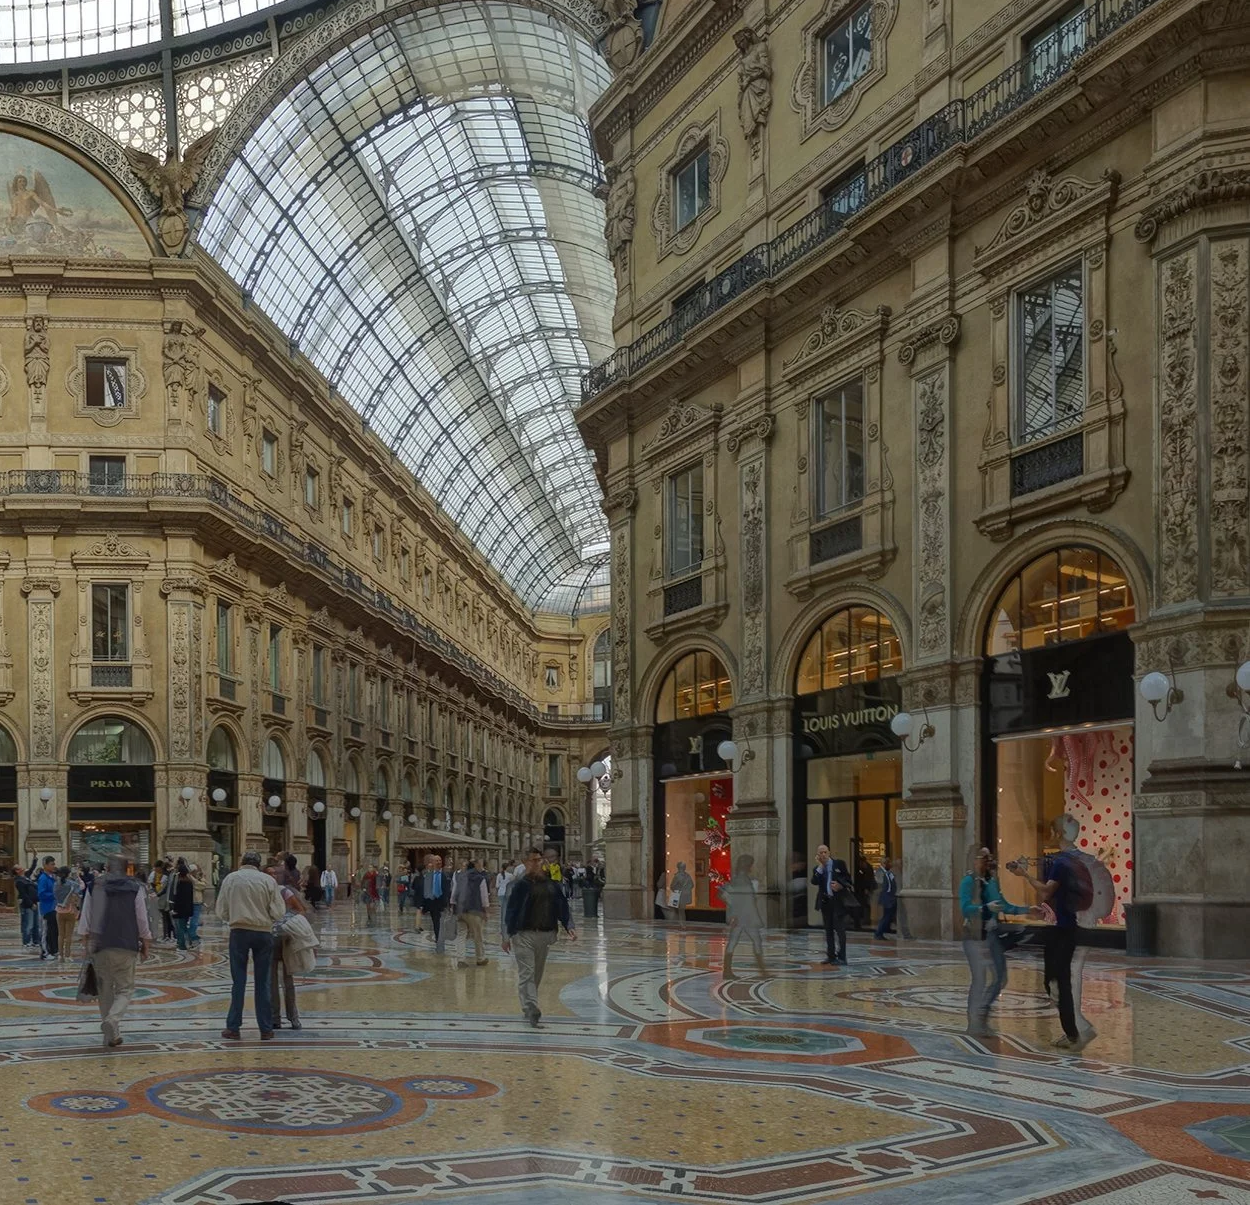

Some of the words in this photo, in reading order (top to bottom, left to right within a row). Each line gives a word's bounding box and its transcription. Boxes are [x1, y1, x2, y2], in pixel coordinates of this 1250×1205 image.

[802, 714, 840, 733] LOUIS
[841, 704, 899, 726] VUITTON
[90, 780, 132, 788] PRADA
